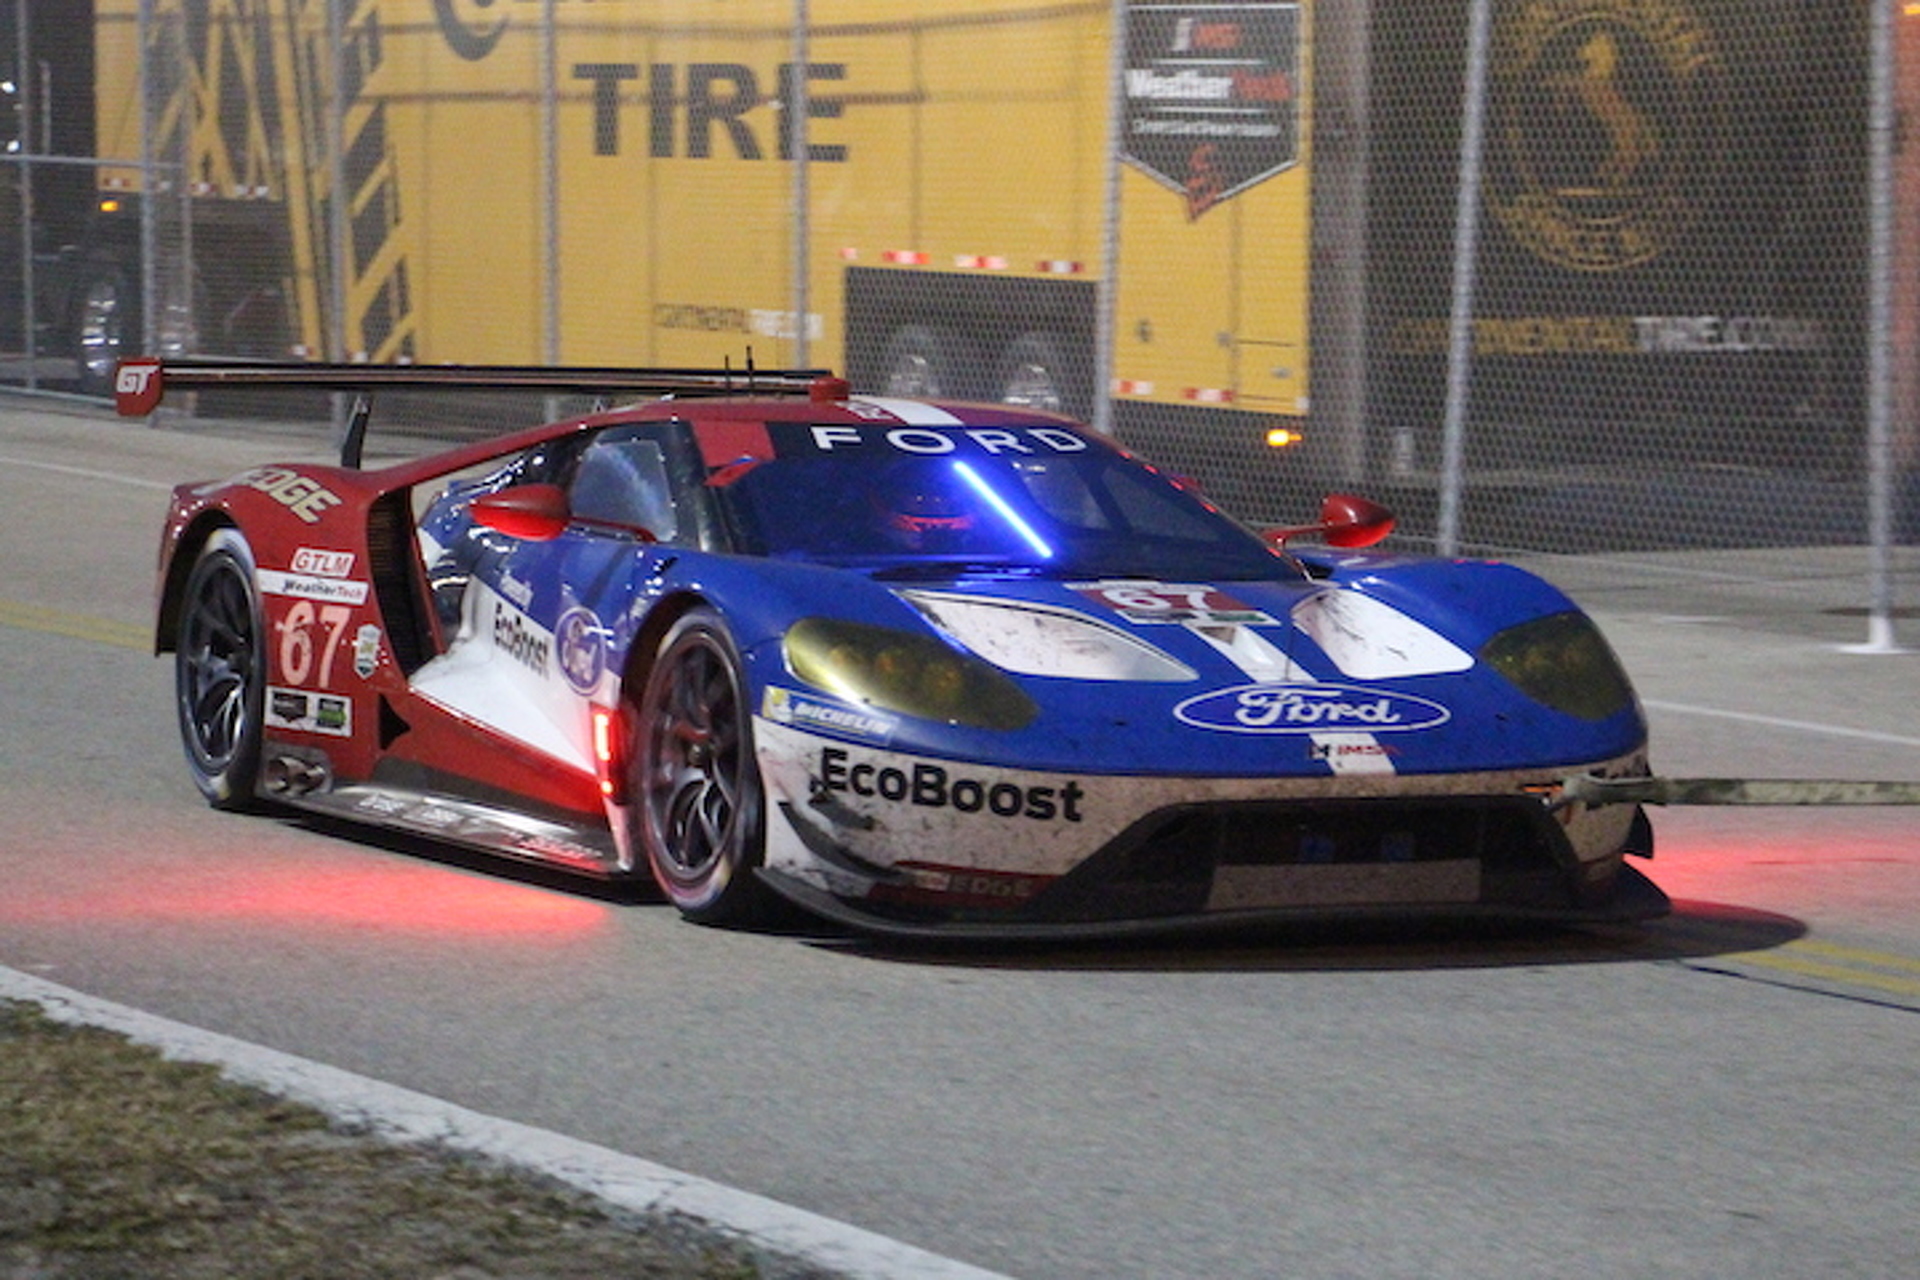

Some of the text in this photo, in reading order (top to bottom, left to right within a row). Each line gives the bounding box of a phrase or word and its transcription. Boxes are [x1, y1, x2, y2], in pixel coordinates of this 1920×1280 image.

[572, 63, 848, 161] TIRE
[117, 365, 159, 395] GT
[810, 426, 1087, 455] FORD
[295, 551, 350, 574] GTLM
[1101, 587, 1212, 610] 67
[280, 600, 351, 688] 67
[793, 701, 892, 735] MICHELIN
[1234, 689, 1400, 726] Ford
[822, 746, 1085, 822] EcoBoost
